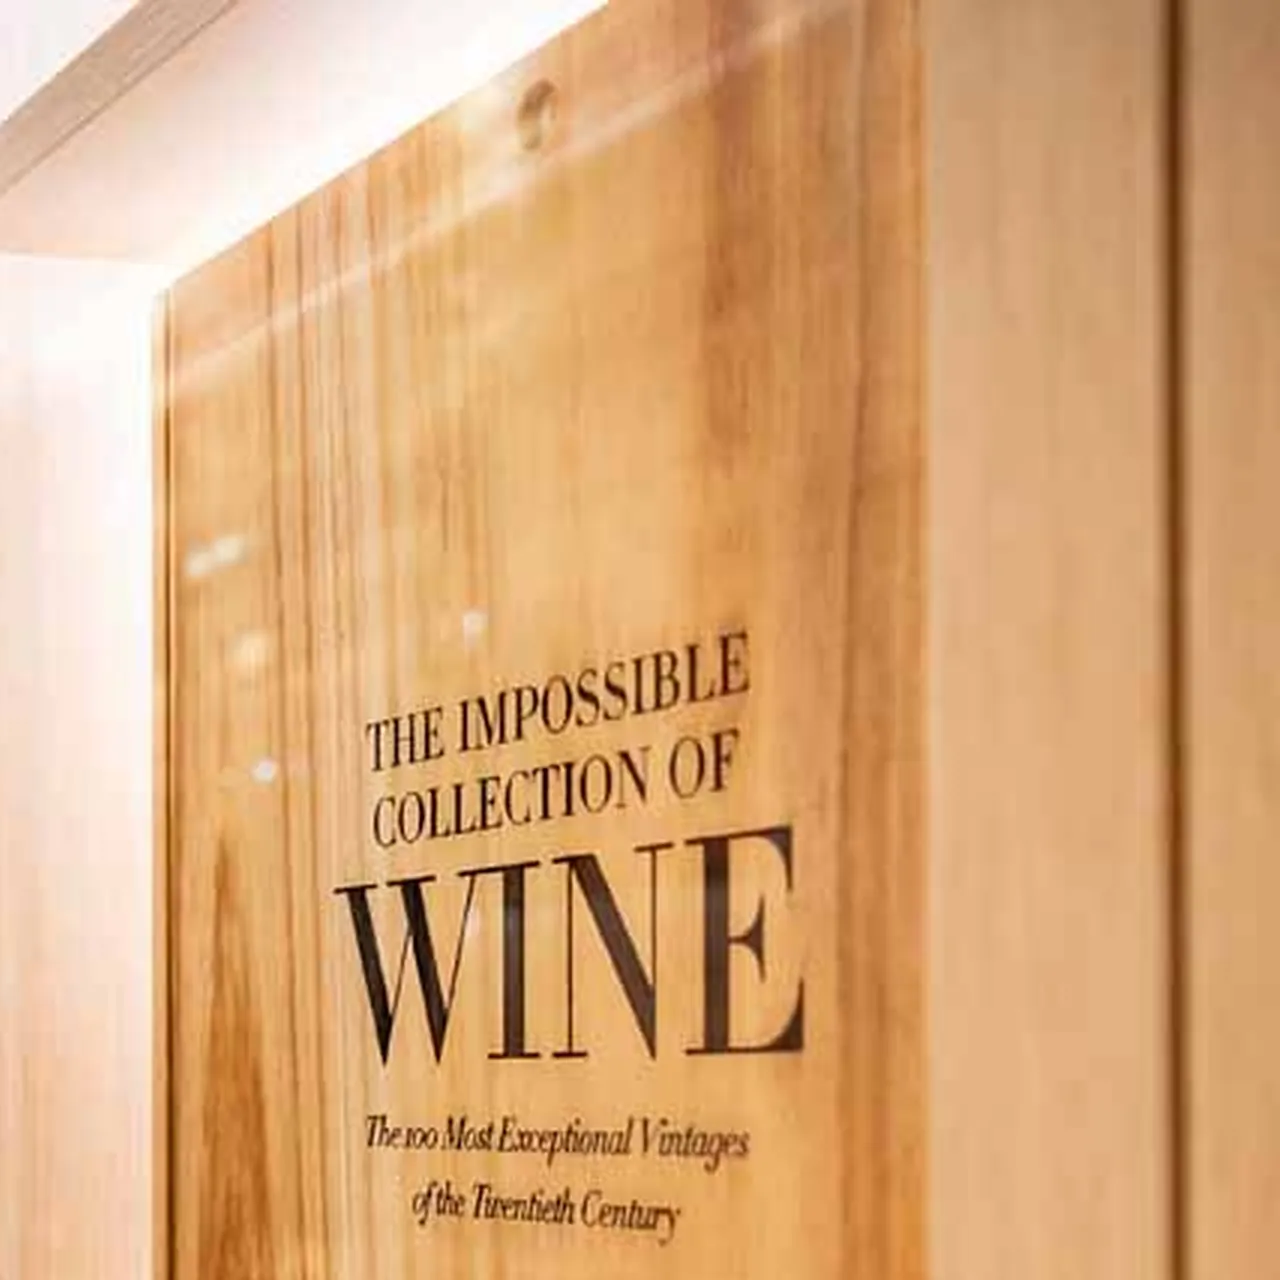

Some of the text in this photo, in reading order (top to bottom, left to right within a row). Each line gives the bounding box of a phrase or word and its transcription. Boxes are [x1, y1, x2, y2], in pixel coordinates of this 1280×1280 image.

[367, 632, 750, 771] THE IMPOSSIBLE
[373, 728, 739, 848] COLLECTION OF
[334, 825, 805, 1064] WINE
[366, 1114, 751, 1173] The 100 Most Exceptional Vintages
[412, 1181, 681, 1247] of the Twentieth Century
